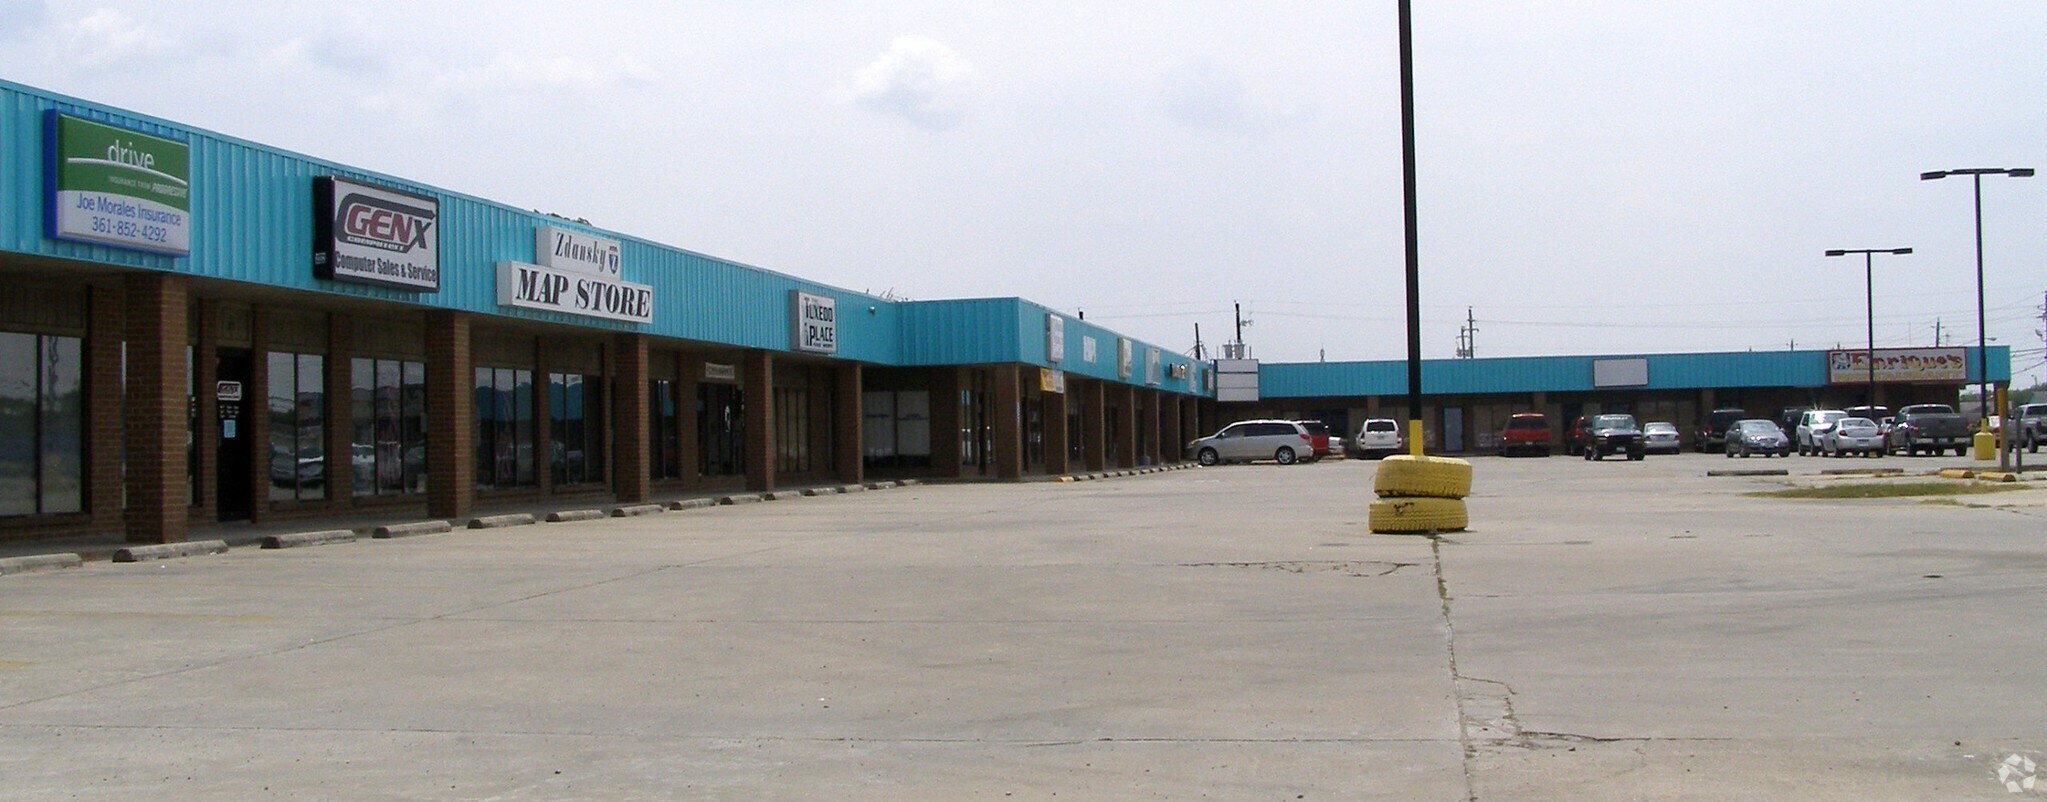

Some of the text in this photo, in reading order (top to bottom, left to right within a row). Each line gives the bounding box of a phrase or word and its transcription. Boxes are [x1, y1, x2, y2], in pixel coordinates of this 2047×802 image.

[107, 139, 155, 169] drive
[77, 193, 182, 227] Joe Morales Insurance
[92, 216, 167, 243] 361-852-4292
[347, 204, 432, 250] GENX
[335, 251, 437, 283] Computer Sales & Service
[555, 231, 607, 272] Zdansky
[516, 267, 651, 318] MAP STORE
[804, 297, 834, 323] TUXEDO
[809, 325, 833, 347] PLACE
